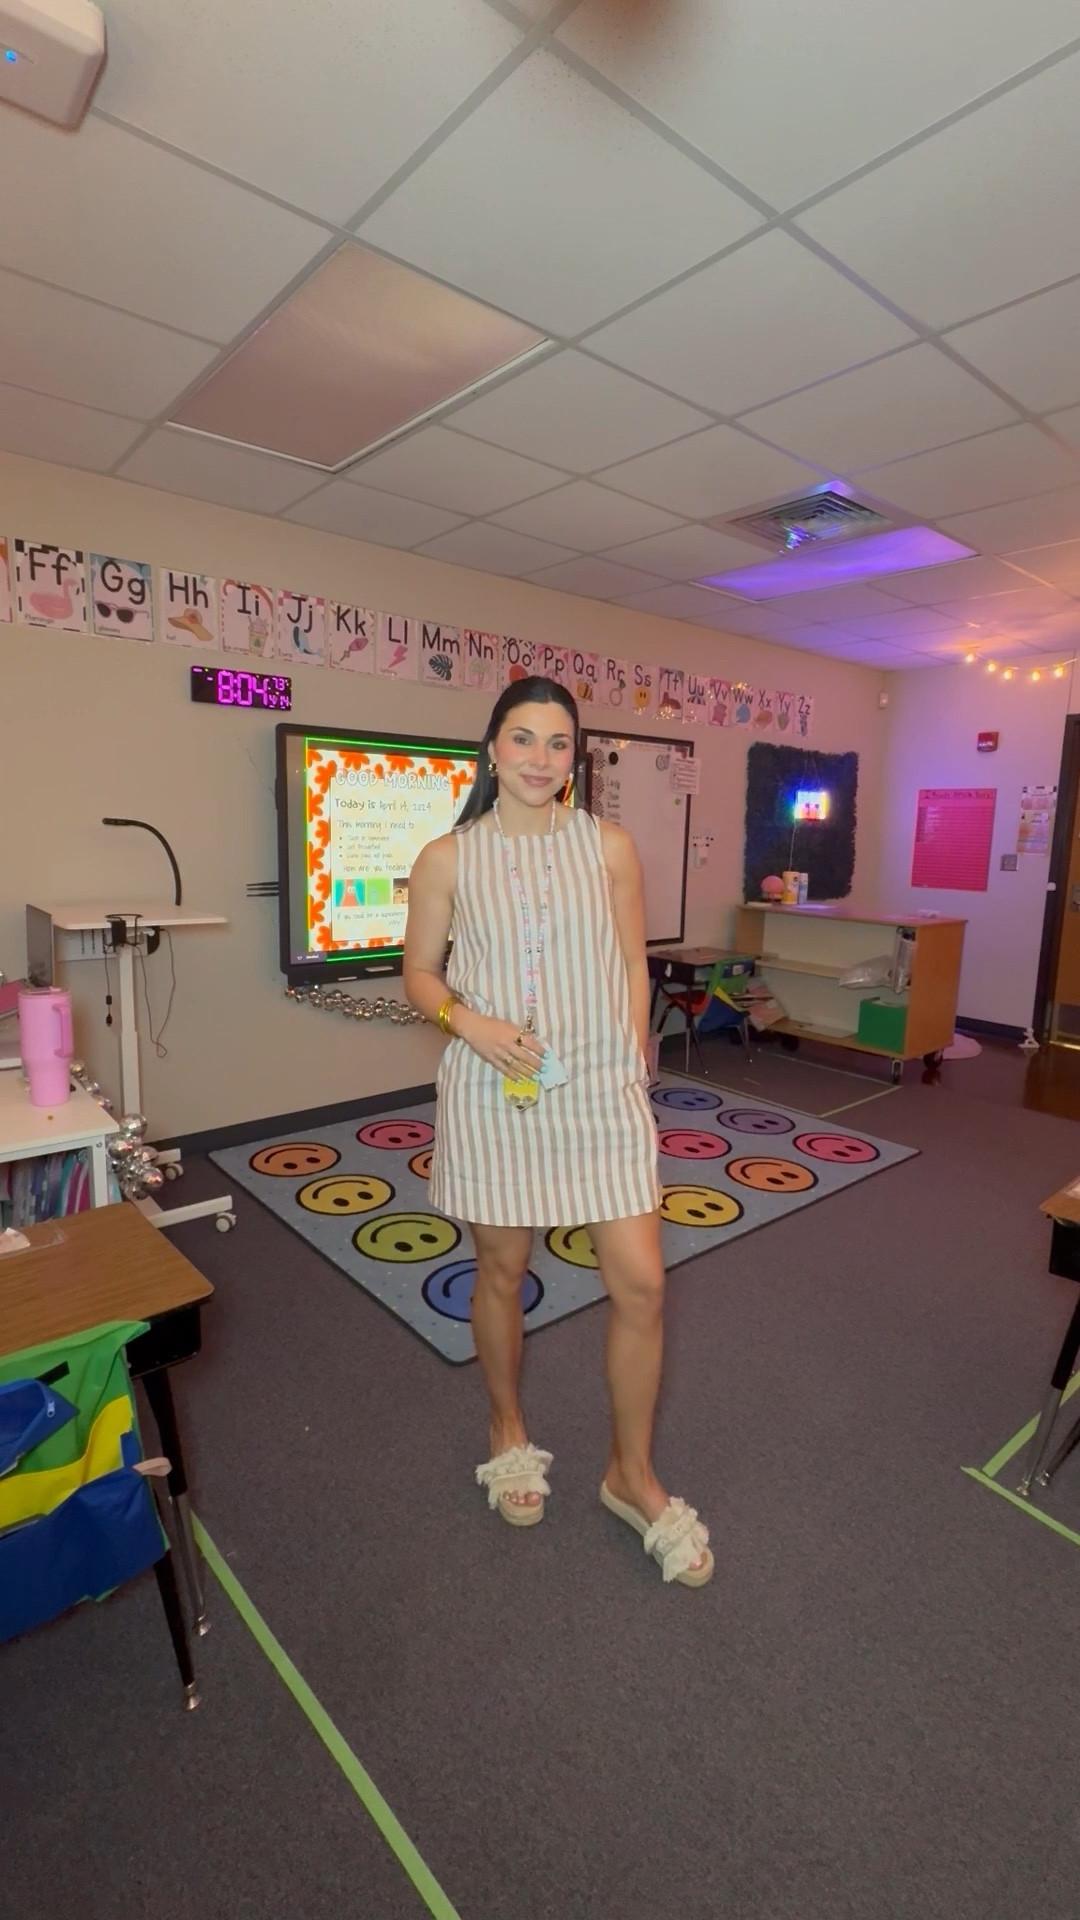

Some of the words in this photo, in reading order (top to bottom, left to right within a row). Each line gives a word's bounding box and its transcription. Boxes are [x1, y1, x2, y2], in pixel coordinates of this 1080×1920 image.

[28, 546, 72, 586] Ff
[100, 560, 146, 605] Gg
[168, 572, 209, 608] Hh
[237, 585, 260, 616] Ii
[286, 594, 314, 634] Jj
[336, 605, 367, 637] Kk
[388, 617, 408, 645] Ll
[422, 624, 460, 655] Mm
[468, 634, 494, 660] Nn
[507, 641, 532, 667] Oo
[543, 647, 565, 676] Pp
[573, 653, 597, 683] Qq
[606, 659, 626, 682] Rr
[217, 670, 269, 706] 8:04
[634, 665, 652, 687] Ss
[664, 670, 680, 692] Tt
[688, 675, 704, 697] Uu
[712, 684, 729, 701] Vv
[733, 688, 754, 705] Ww
[758, 689, 772, 709] Xx
[778, 692, 790, 714] Yy
[798, 697, 811, 716] Zz
[335, 769, 378, 786] GOOD
[383, 771, 450, 791] MORNING
[334, 798, 365, 810] Today
[368, 799, 376, 809] is
[412, 802, 432, 811] 2024
